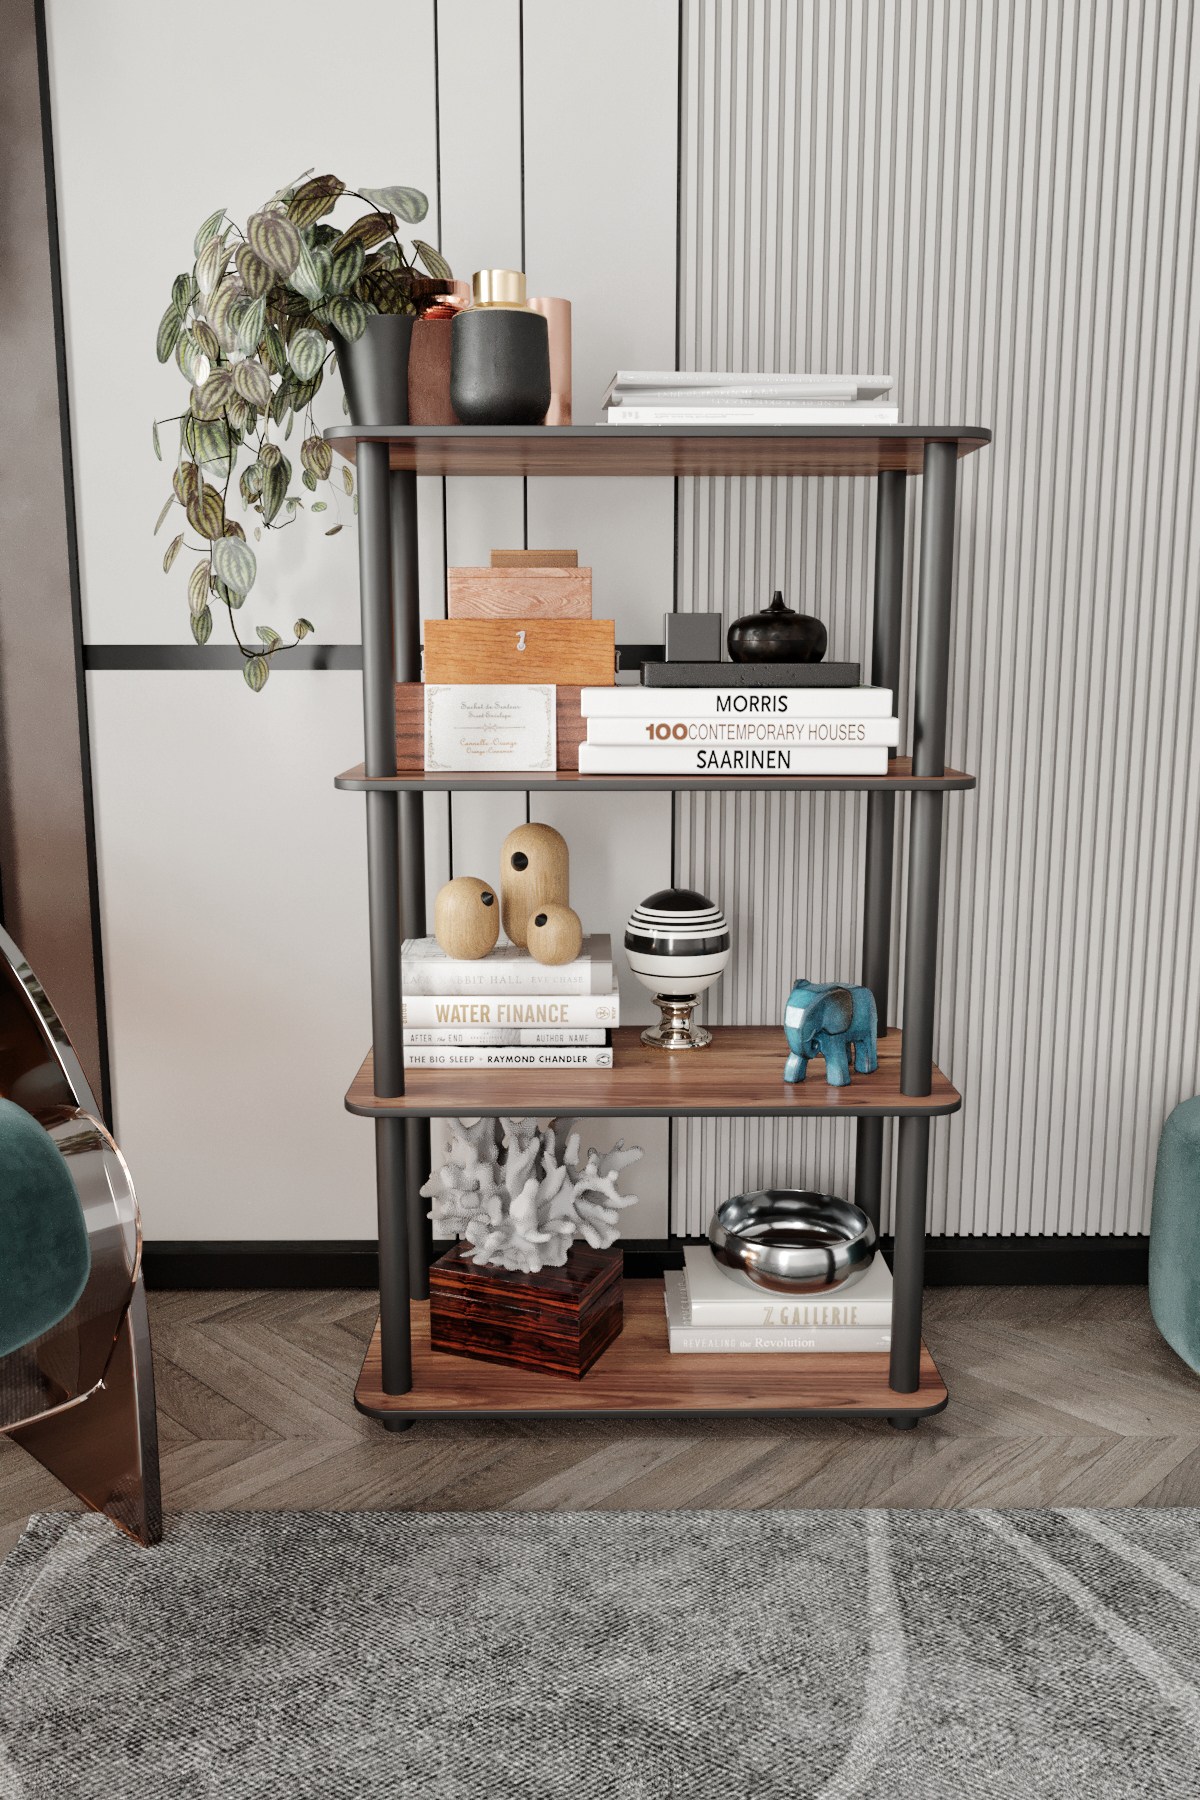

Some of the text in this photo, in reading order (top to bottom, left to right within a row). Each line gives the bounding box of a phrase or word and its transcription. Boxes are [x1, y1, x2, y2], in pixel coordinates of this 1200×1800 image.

[716, 695, 788, 712] MORRIS
[645, 723, 865, 741] 100 CONTEMPORARY HOUSES
[696, 750, 791, 769] SAARINEN
[490, 975, 522, 984] HALL
[553, 976, 584, 984] CHASE
[436, 1004, 569, 1023] WATER FINANCE
[410, 1034, 432, 1042] AFTER
[448, 1034, 463, 1042] END
[536, 1034, 589, 1042] AUTHOR NAME
[487, 1055, 588, 1063] RAYMOND CHANDLER
[763, 1306, 858, 1325] Z GALLERIE
[683, 1339, 736, 1348] REVEALING
[755, 1337, 816, 1348] Revolution
